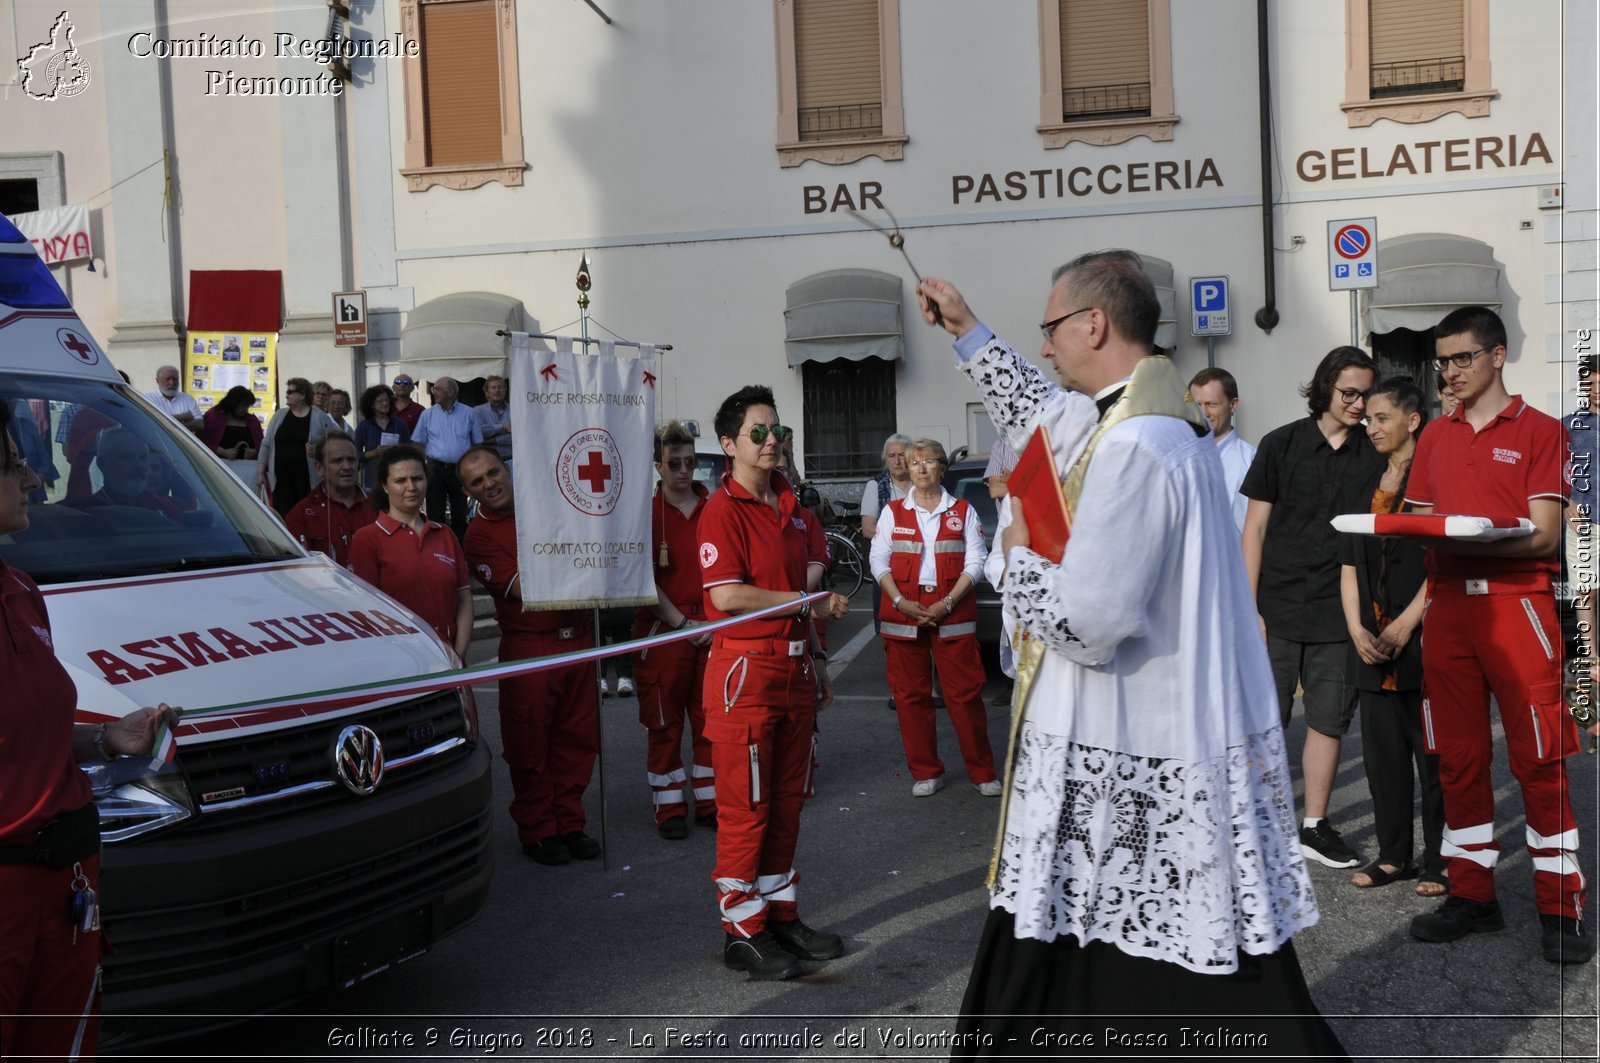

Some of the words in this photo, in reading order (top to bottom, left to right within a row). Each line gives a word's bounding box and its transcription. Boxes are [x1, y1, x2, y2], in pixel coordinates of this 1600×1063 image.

[1296, 132, 1553, 183] GELATERIA
[952, 158, 1224, 204] PASTICCERIA
[803, 181, 884, 214] BAR
[30, 231, 91, 263] NYA
[1338, 265, 1347, 277] P
[1201, 285, 1218, 307] P
[526, 391, 564, 405] CROCE
[567, 393, 604, 405] ROSSA
[606, 394, 645, 406] ITALIANA
[569, 444, 577, 453] DI
[576, 434, 608, 445] GINEVRA
[562, 454, 592, 509] CONVENZIONE
[532, 542, 602, 555] COMITATO
[604, 542, 636, 555] LOCALE
[573, 556, 618, 569] GALLIATE
